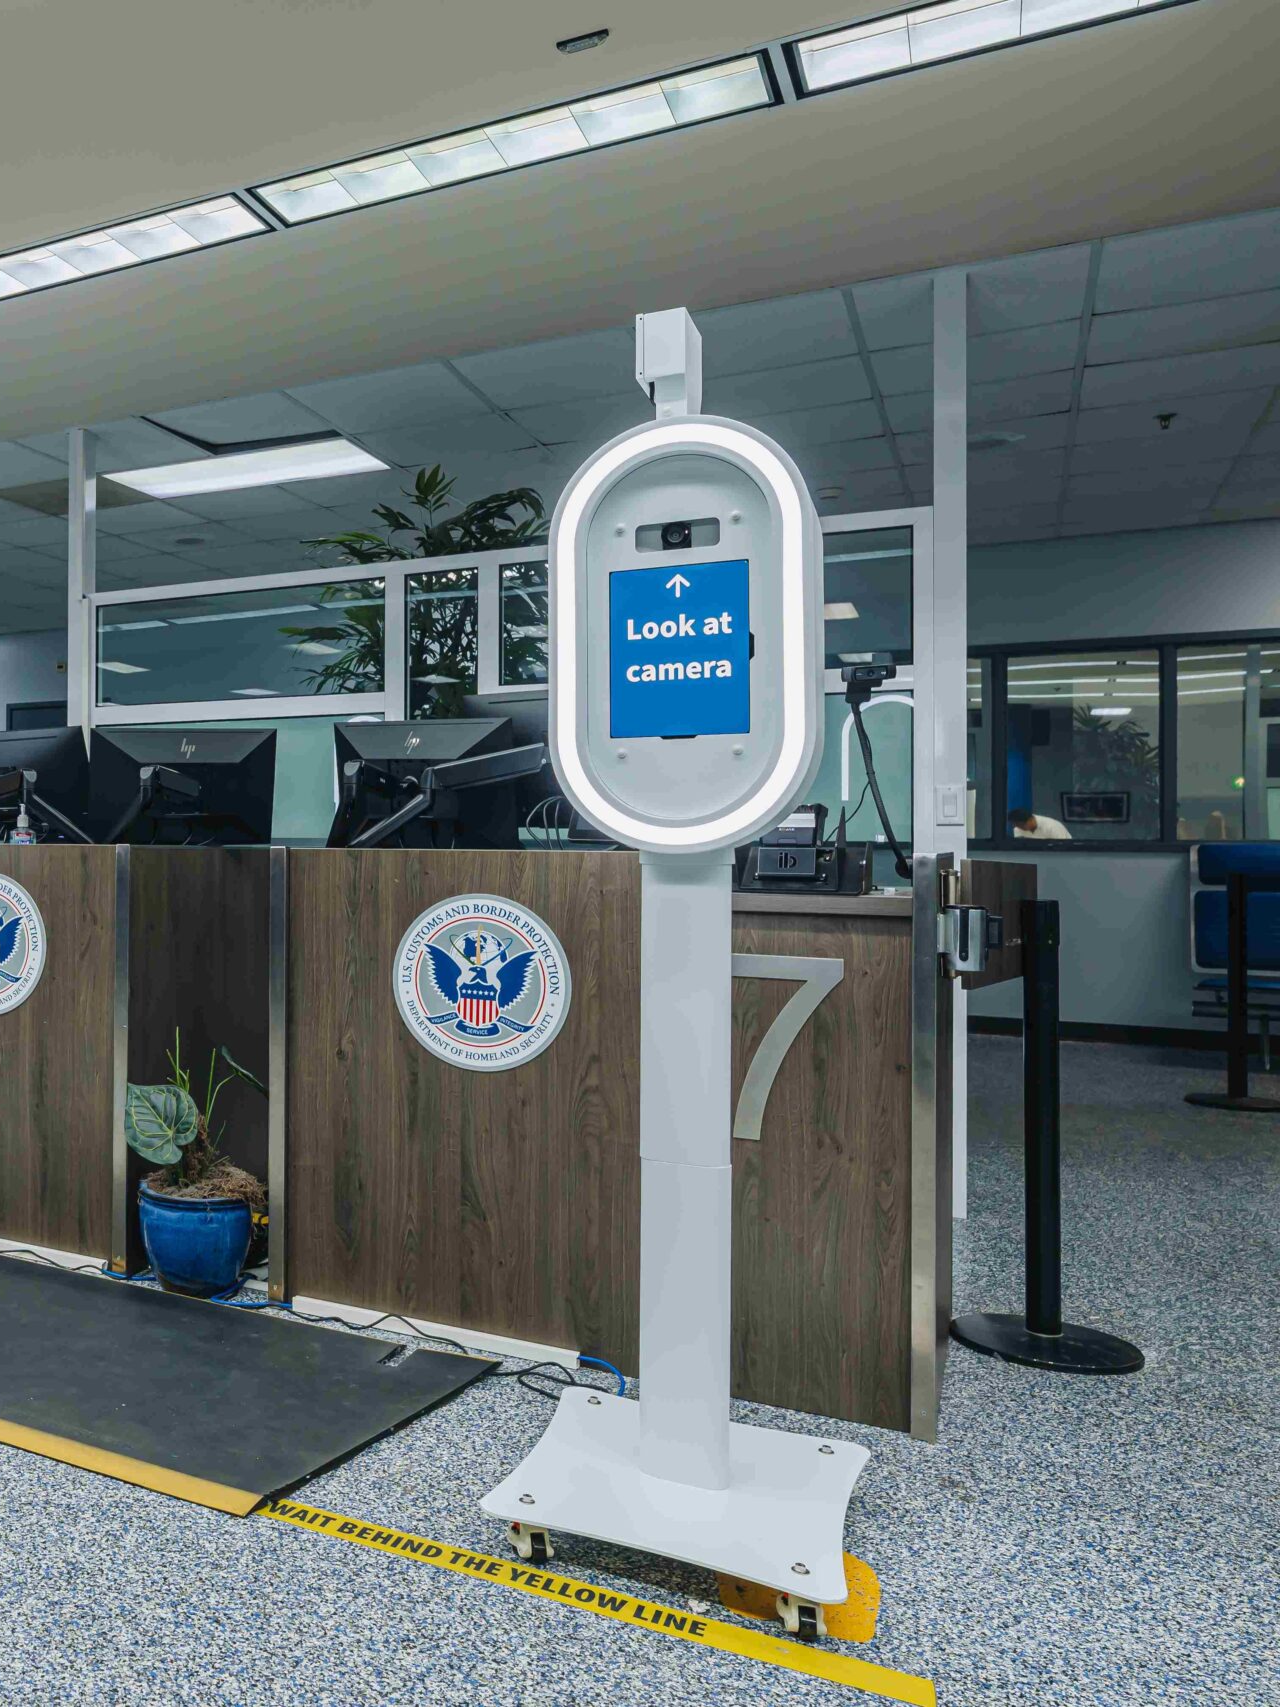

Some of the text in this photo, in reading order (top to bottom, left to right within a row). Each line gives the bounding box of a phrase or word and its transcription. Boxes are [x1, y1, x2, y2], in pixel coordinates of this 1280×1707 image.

[627, 612, 732, 640] Look at
[626, 659, 732, 682] camera
[180, 738, 196, 759] hp
[404, 731, 420, 755] hp
[12, 893, 38, 952] PROTECTION
[402, 903, 559, 996] U.S. CUSTOMS AND BORDER PROTECTION
[12, 966, 35, 998] SECURITY
[406, 999, 554, 1061] DEPARTMENT OF HOMELAND SECURITY
[466, 1027, 489, 1035] SERVICE
[731, 953, 844, 1141] 7
[268, 1500, 708, 1637] WAIT BEHIND THE YELLOW LINE
